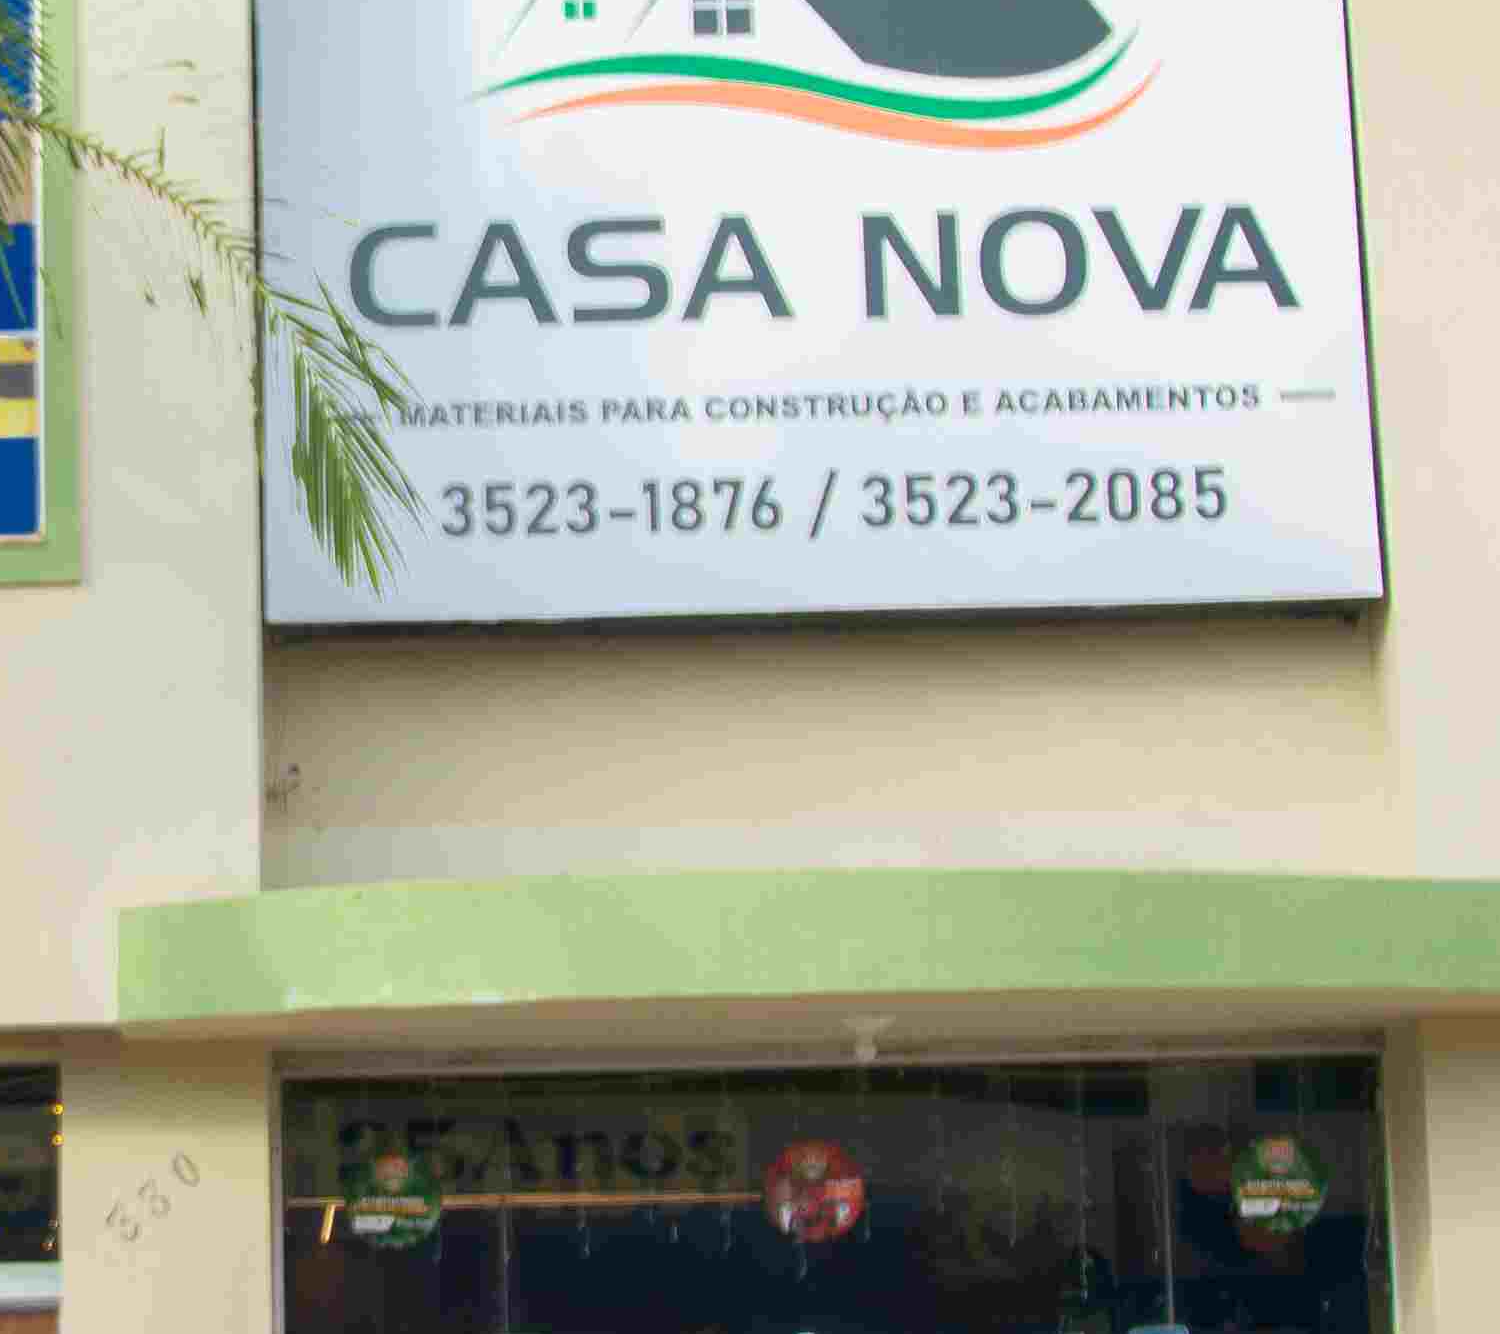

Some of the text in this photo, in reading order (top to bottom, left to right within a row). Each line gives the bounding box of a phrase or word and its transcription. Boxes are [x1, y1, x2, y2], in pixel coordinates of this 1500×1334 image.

[347, 204, 1303, 330] CASA NOVA
[399, 383, 1261, 427] MATERIAIS PARA CONSTRUÇÃO E ACABAMENTOS
[441, 463, 1228, 539] 3523-1876 / 3523-2085
